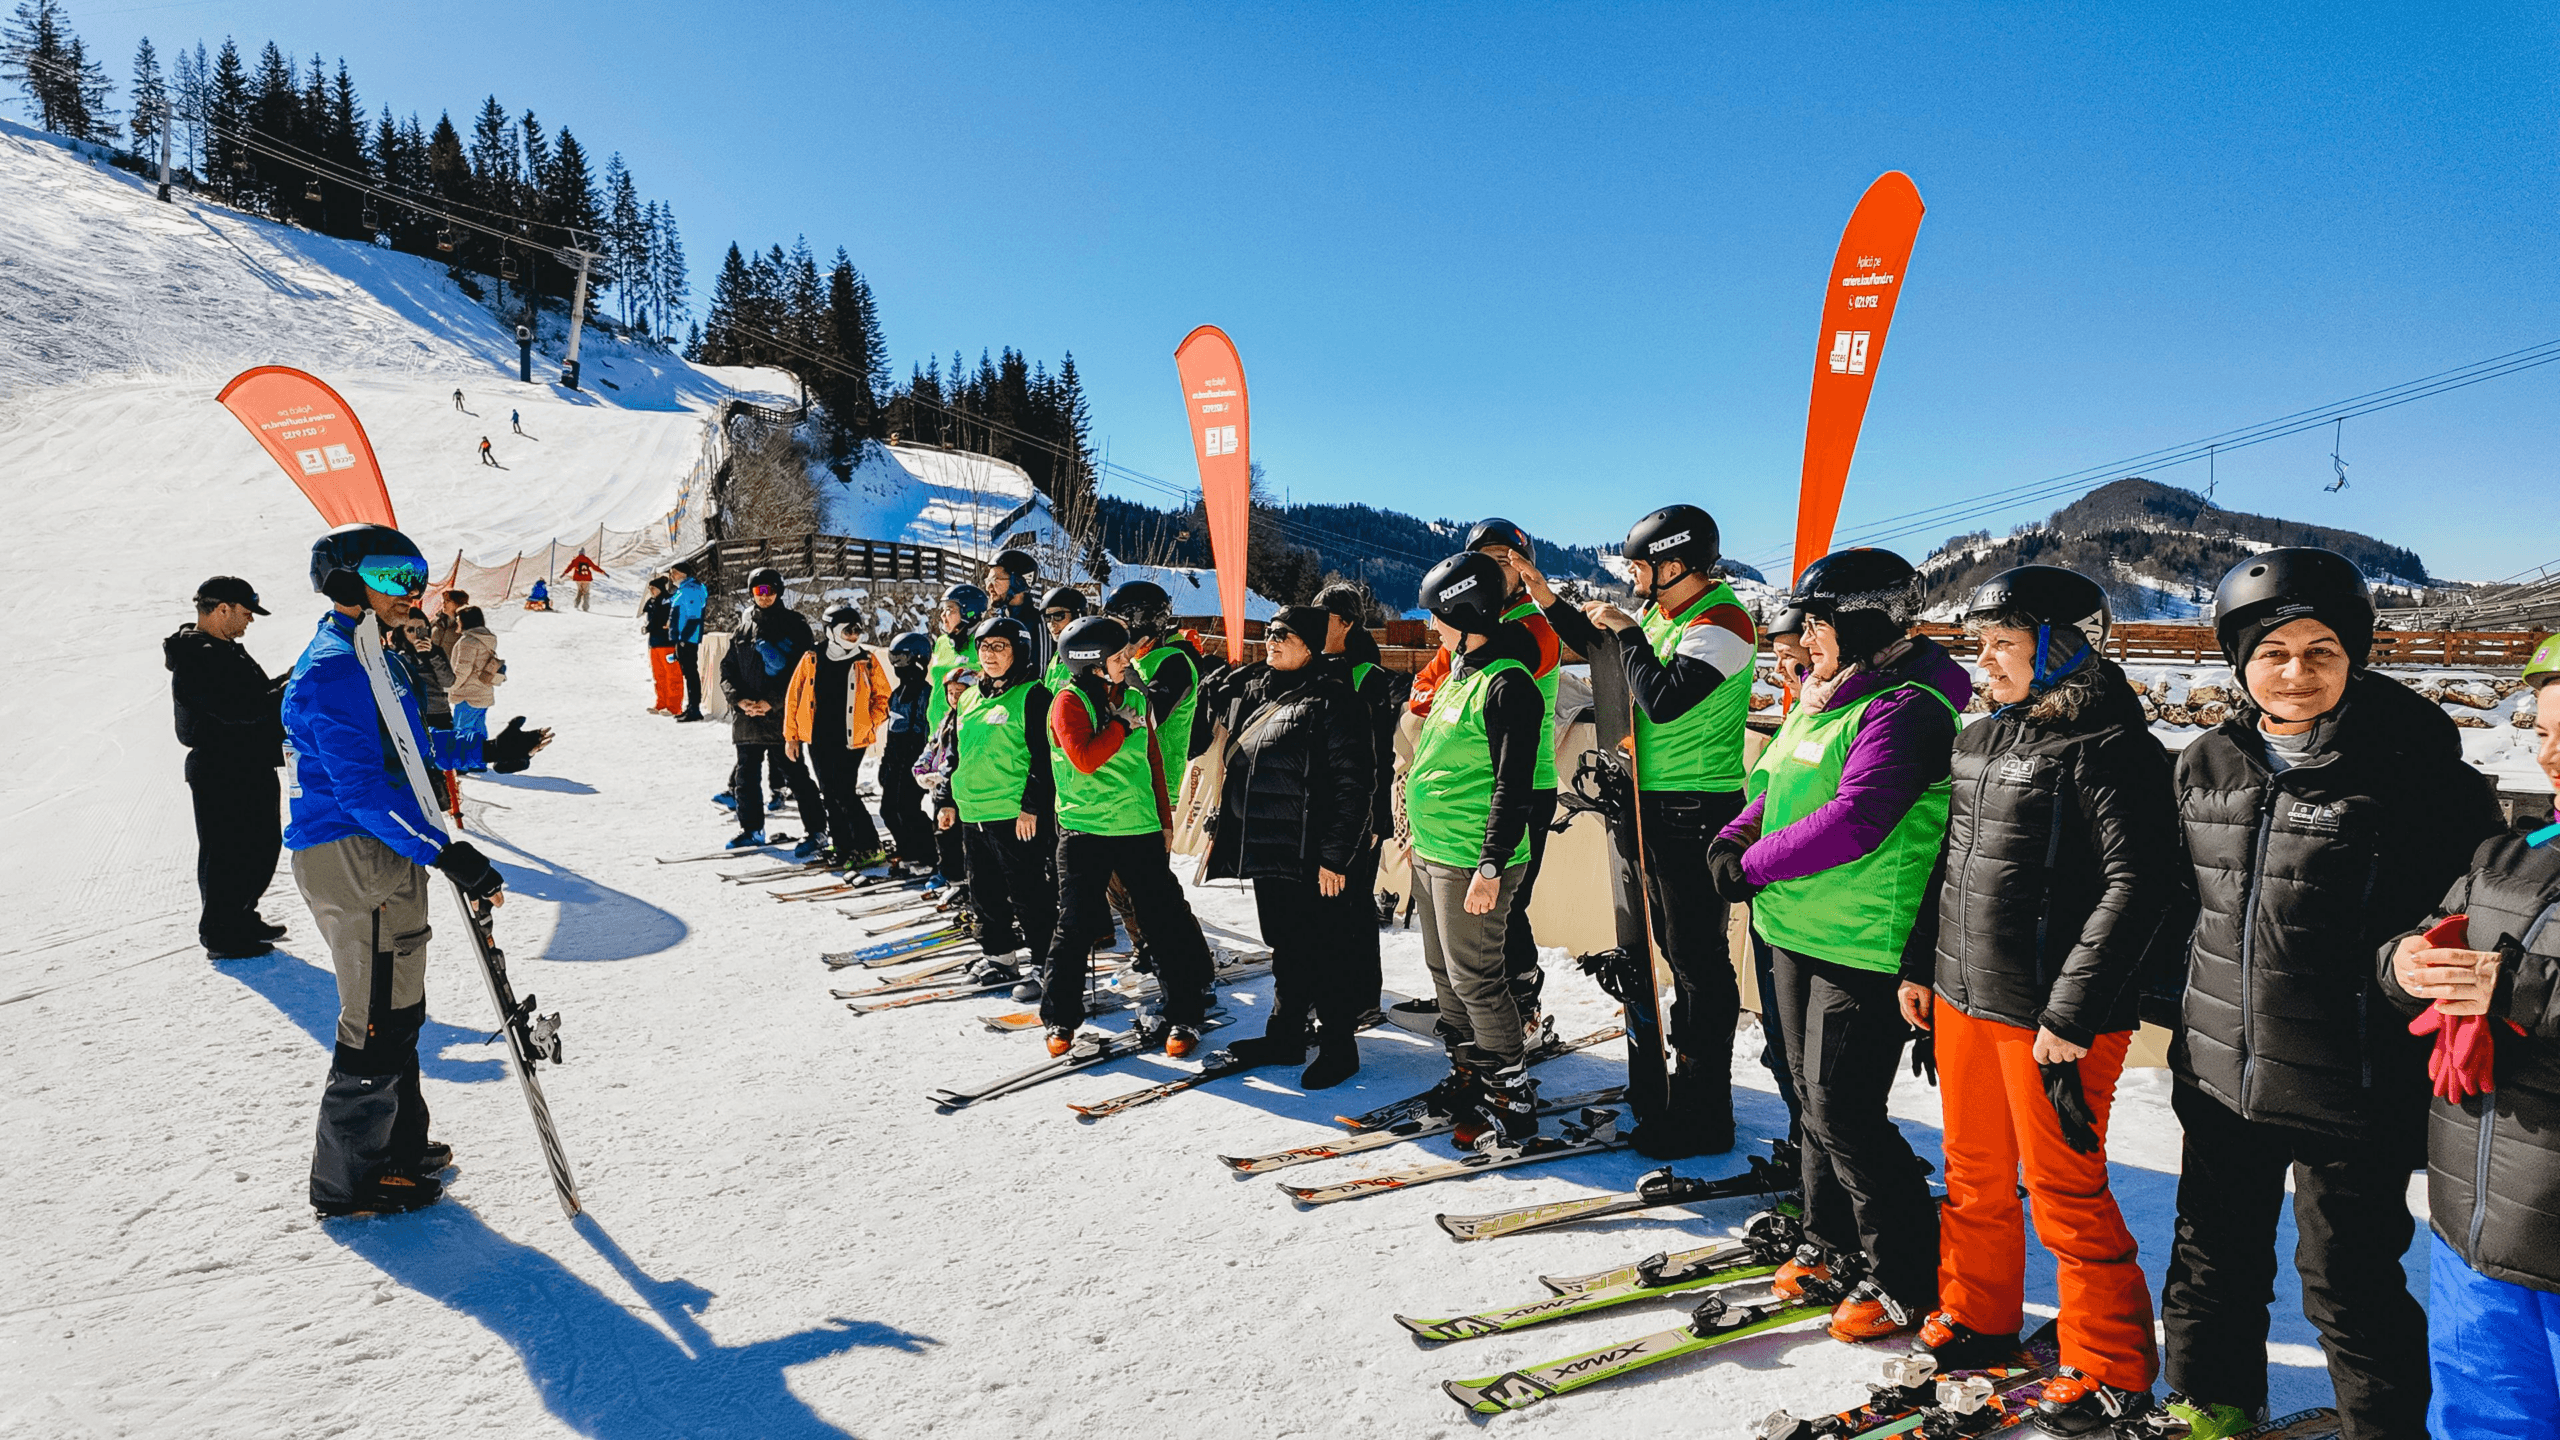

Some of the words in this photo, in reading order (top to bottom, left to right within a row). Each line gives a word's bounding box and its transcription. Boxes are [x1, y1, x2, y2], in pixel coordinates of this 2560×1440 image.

[1648, 530, 1691, 555] ROCES
[1438, 574, 1478, 603] ROCES
[1068, 649, 1102, 660] ROCES
[1502, 1293, 1594, 1320] XMAX
[1552, 1341, 1648, 1379] XMAX
